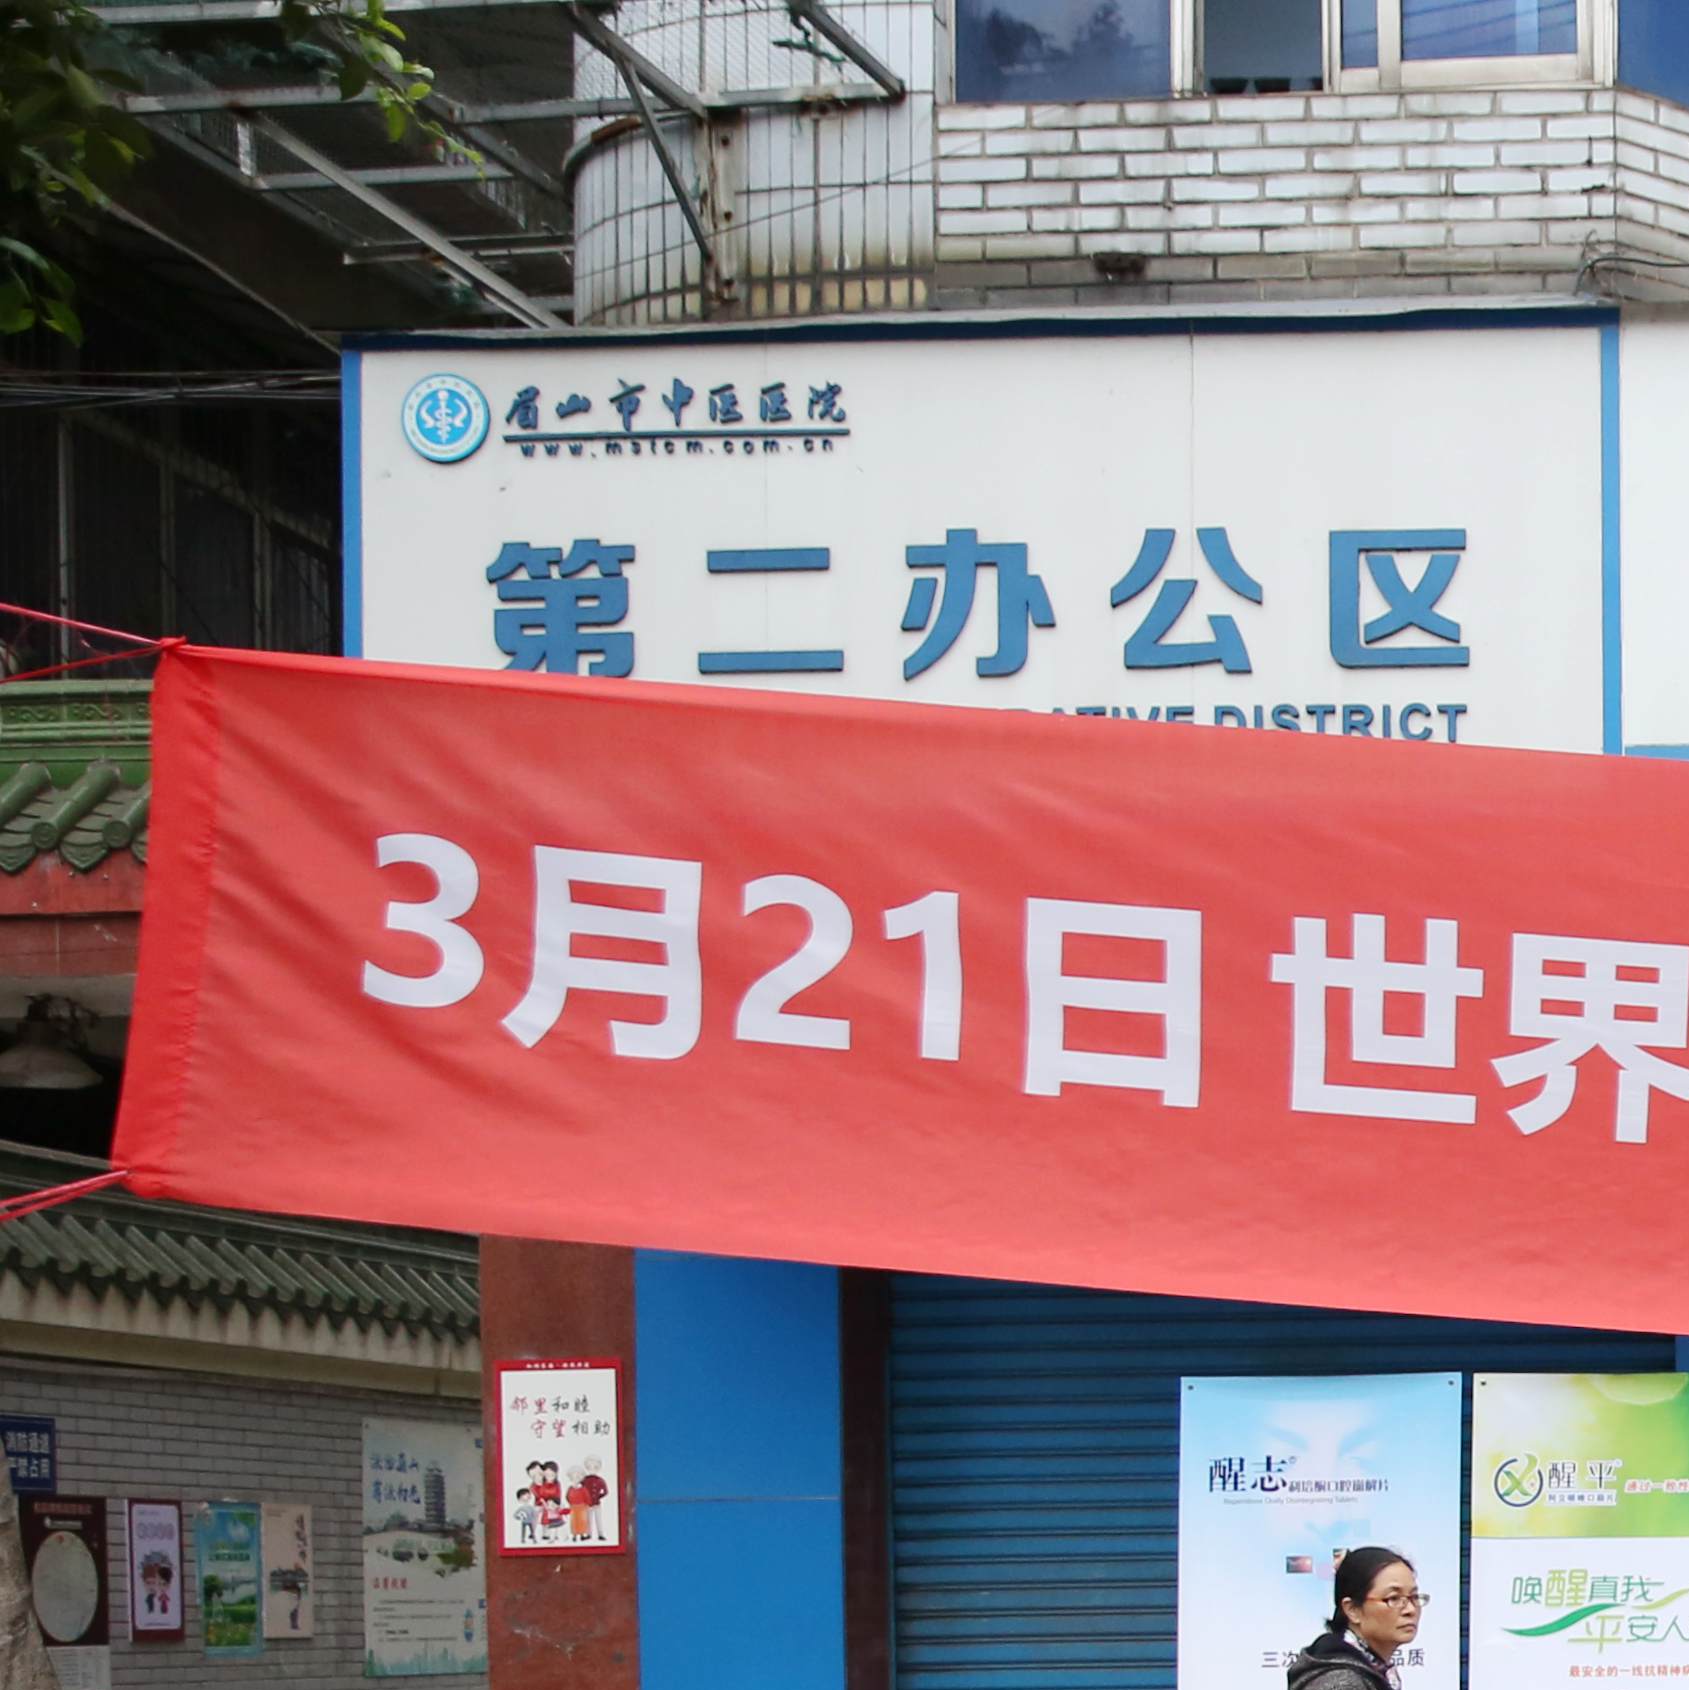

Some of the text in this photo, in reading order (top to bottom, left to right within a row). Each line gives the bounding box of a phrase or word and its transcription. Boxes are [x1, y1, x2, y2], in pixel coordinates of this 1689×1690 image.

[505, 376, 847, 432] 眉山市中医医院
[520, 437, 834, 458] www.mstcm.com.cn
[487, 527, 1471, 679] 第二办公区
[1209, 1455, 1288, 1493] 醒志
[1510, 1568, 1665, 1609] 唤醒真我
